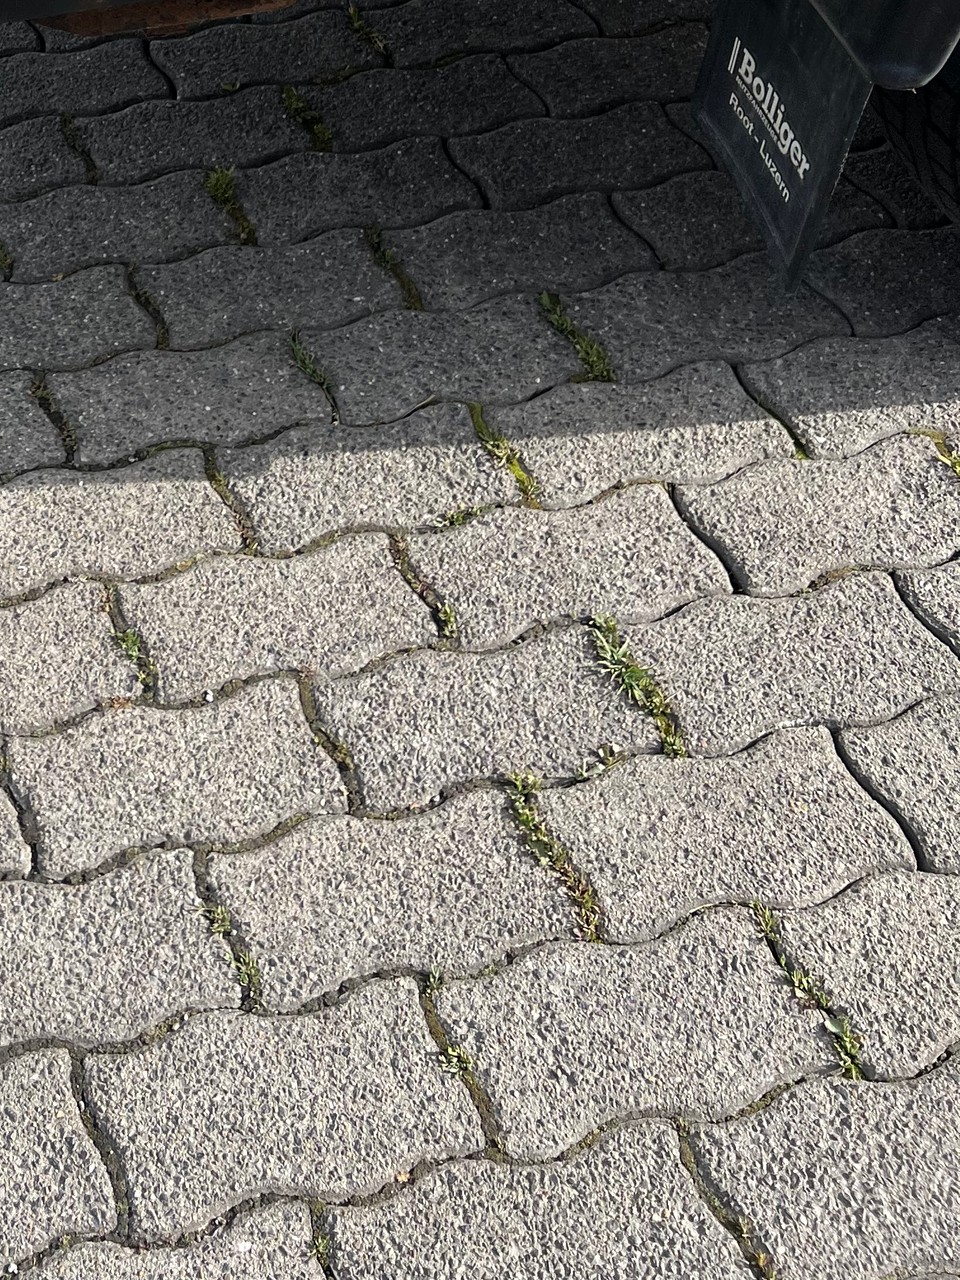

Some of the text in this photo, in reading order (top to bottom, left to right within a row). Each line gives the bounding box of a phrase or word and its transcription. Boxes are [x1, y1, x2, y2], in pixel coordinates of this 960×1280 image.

[729, 92, 755, 135] Root
[759, 139, 791, 203] Luzern
[738, 47, 811, 180] Bolliger
